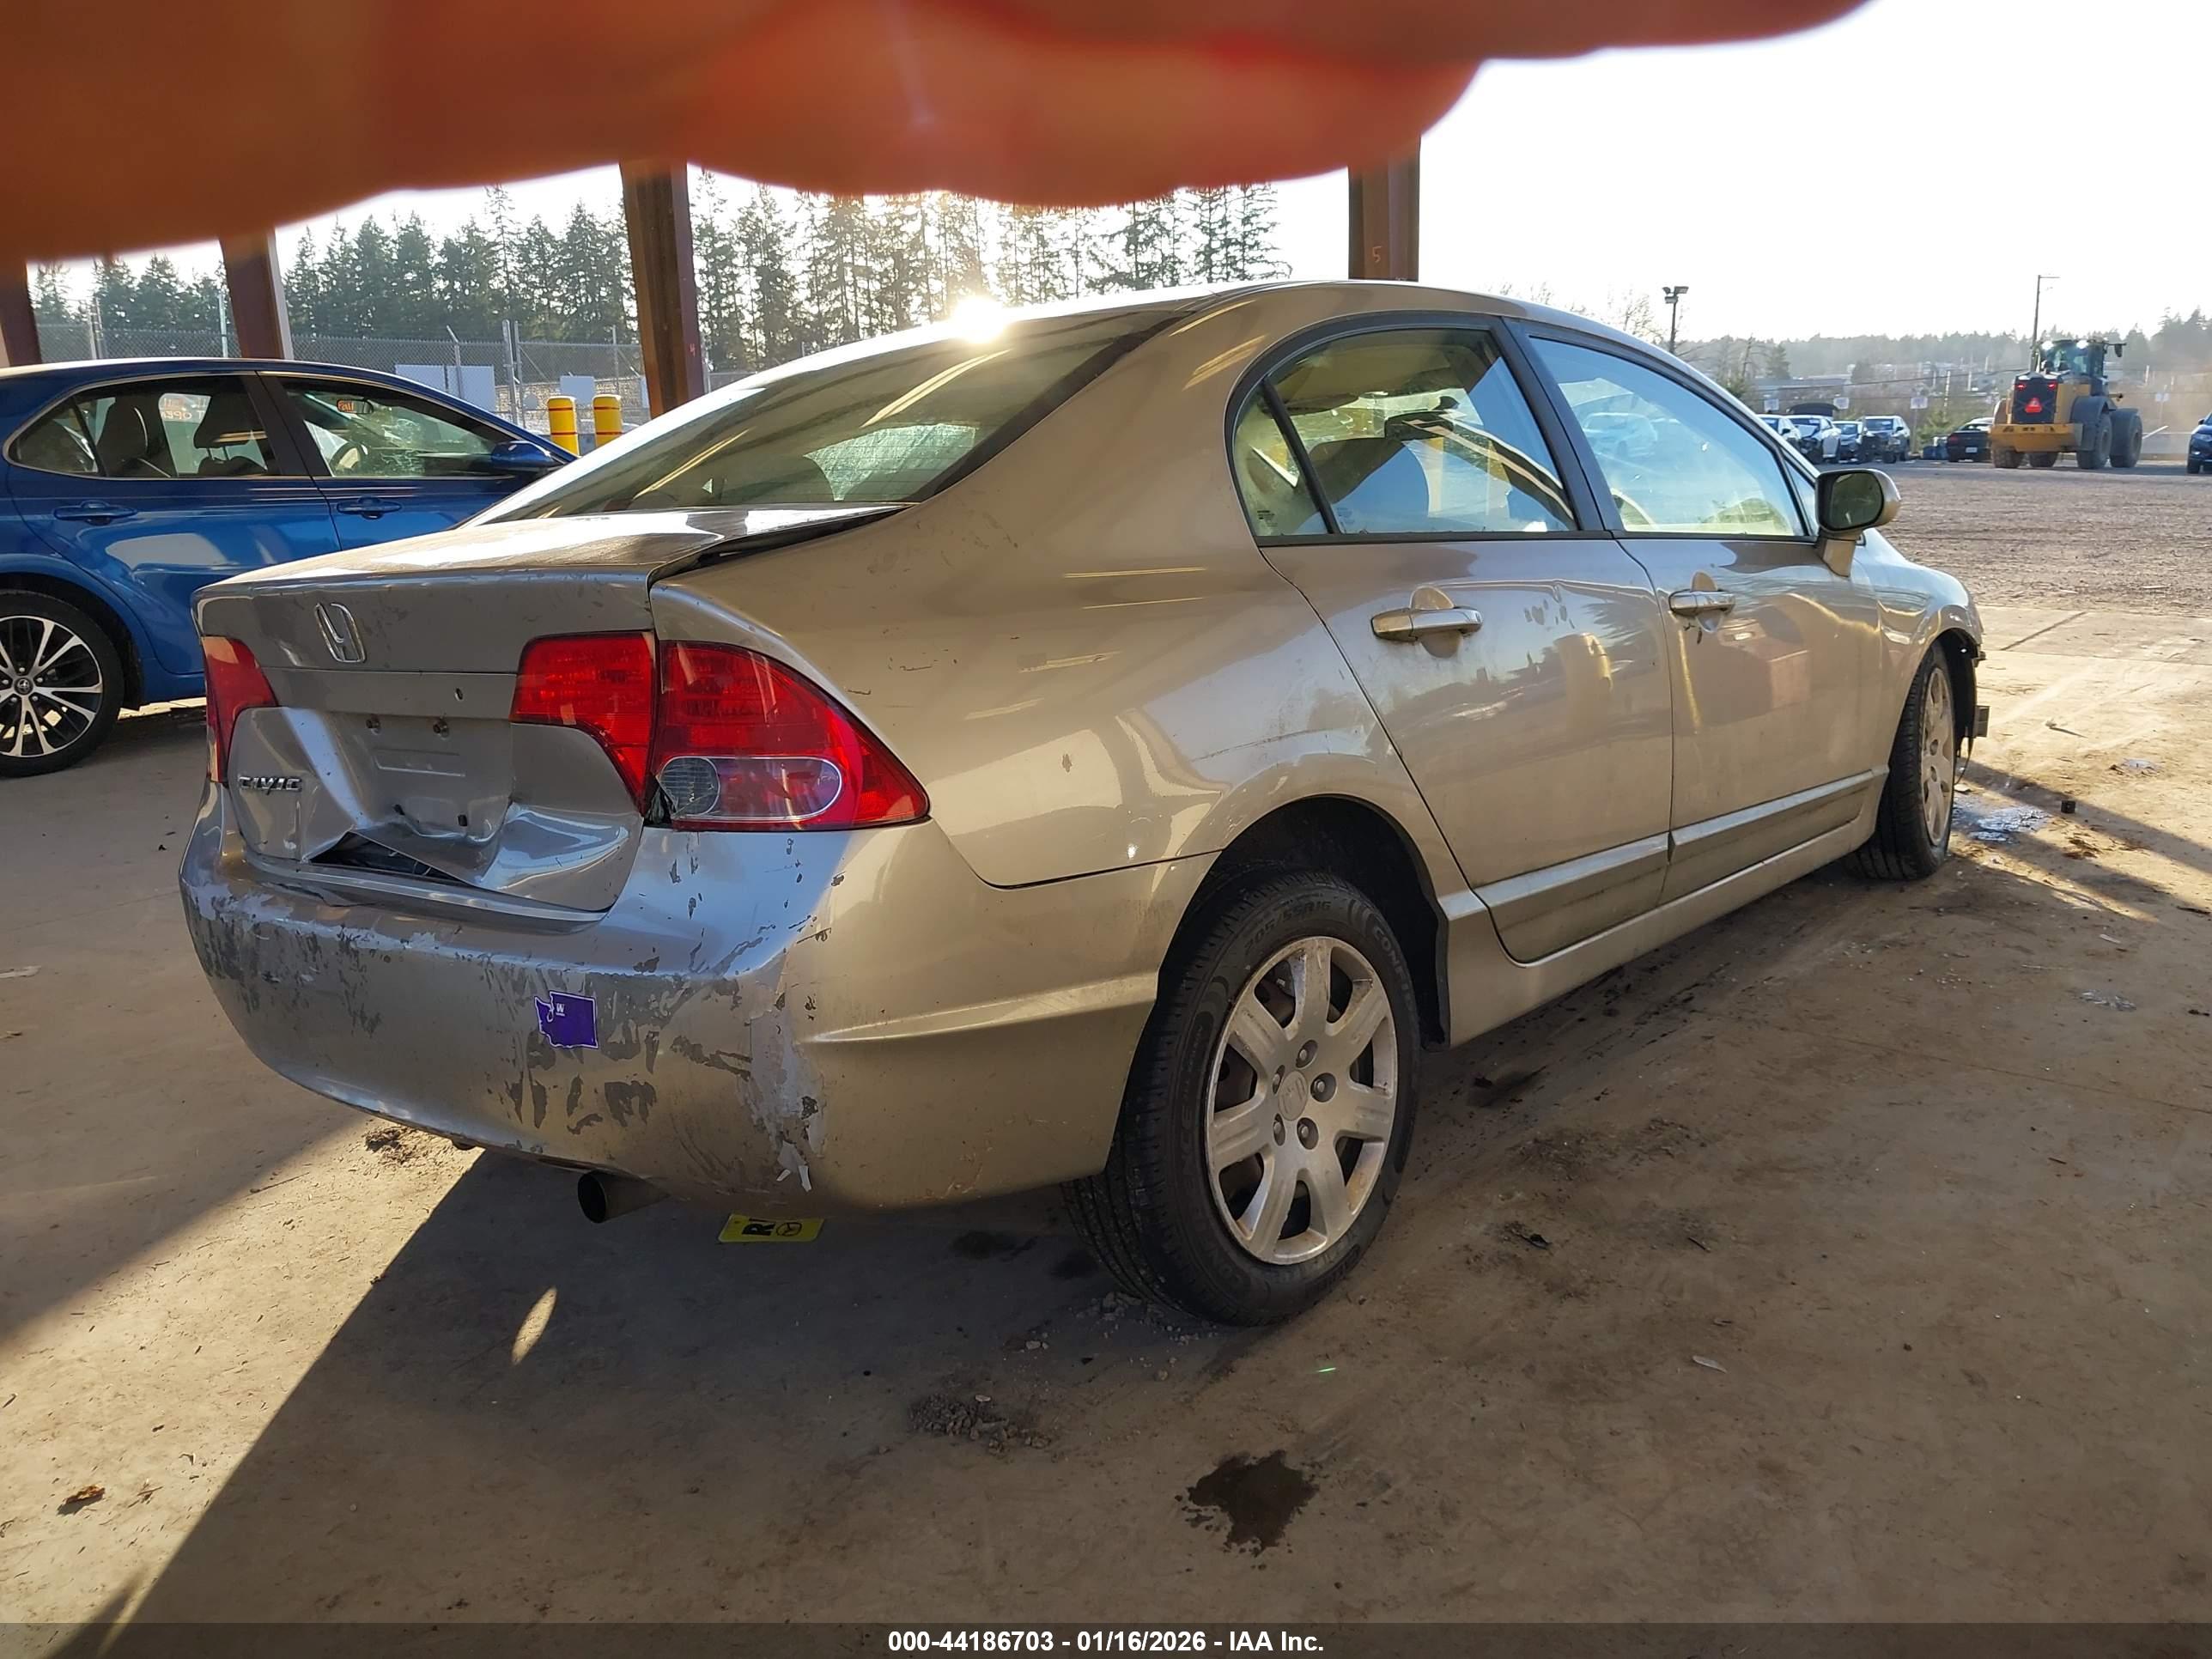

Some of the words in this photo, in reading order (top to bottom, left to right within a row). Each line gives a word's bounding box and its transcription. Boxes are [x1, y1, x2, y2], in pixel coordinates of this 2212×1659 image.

[1372, 246, 1382, 263] 5
[237, 775, 301, 793] CIVIC
[556, 1002, 565, 1013] W
[742, 1218, 776, 1237] R
